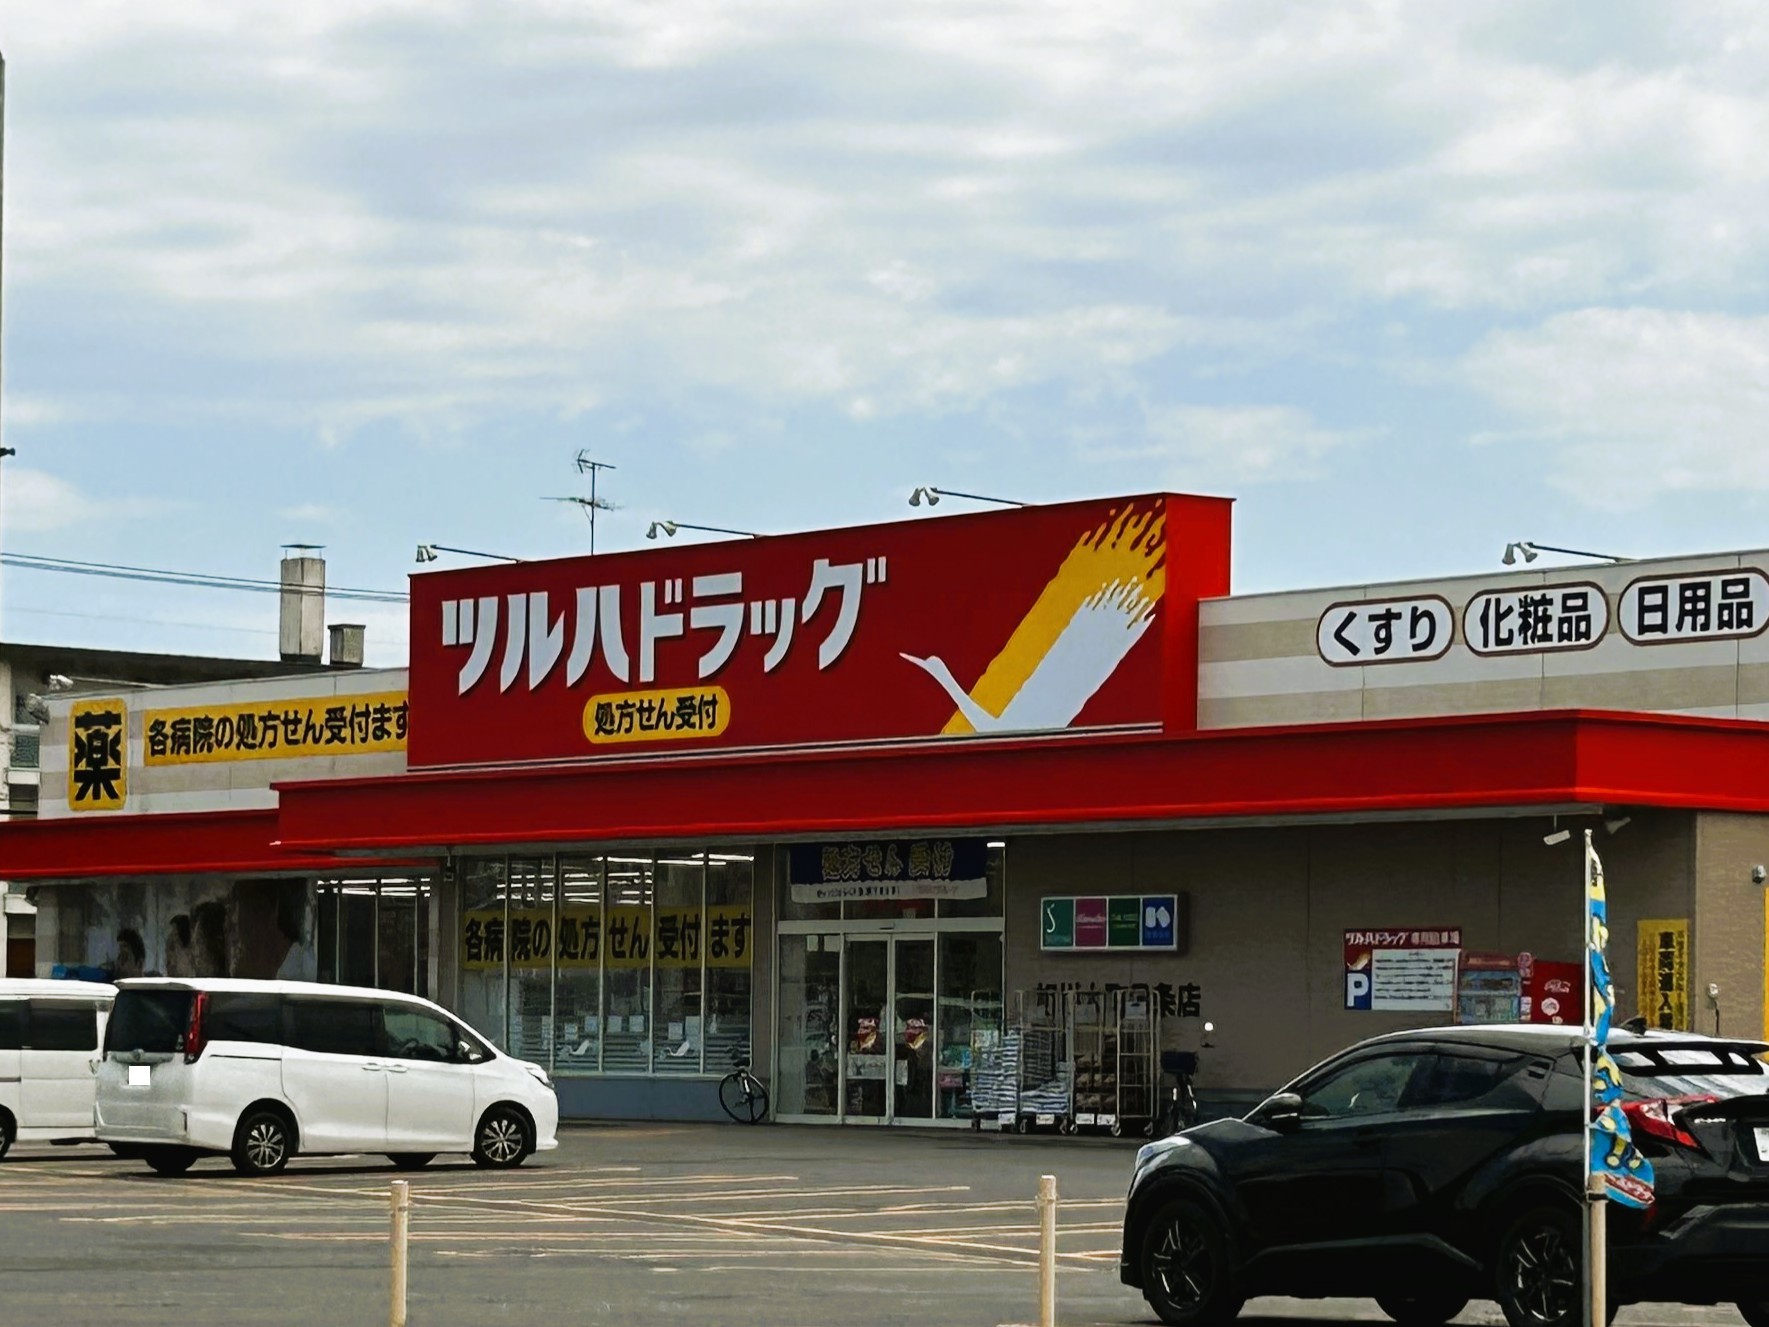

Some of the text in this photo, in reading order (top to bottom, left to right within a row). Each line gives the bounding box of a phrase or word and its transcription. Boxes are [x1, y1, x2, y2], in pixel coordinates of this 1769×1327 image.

[442, 556, 887, 696] ツルハドラッグ
[1333, 606, 1438, 657] くすり
[1479, 591, 1592, 649] 化粧品
[1637, 577, 1754, 636] 日用品
[148, 701, 409, 757] 各病院の処方せん受付ます
[595, 695, 719, 736] 処方せん受付
[74, 710, 122, 801] 薬
[1347, 973, 1369, 1008] P
